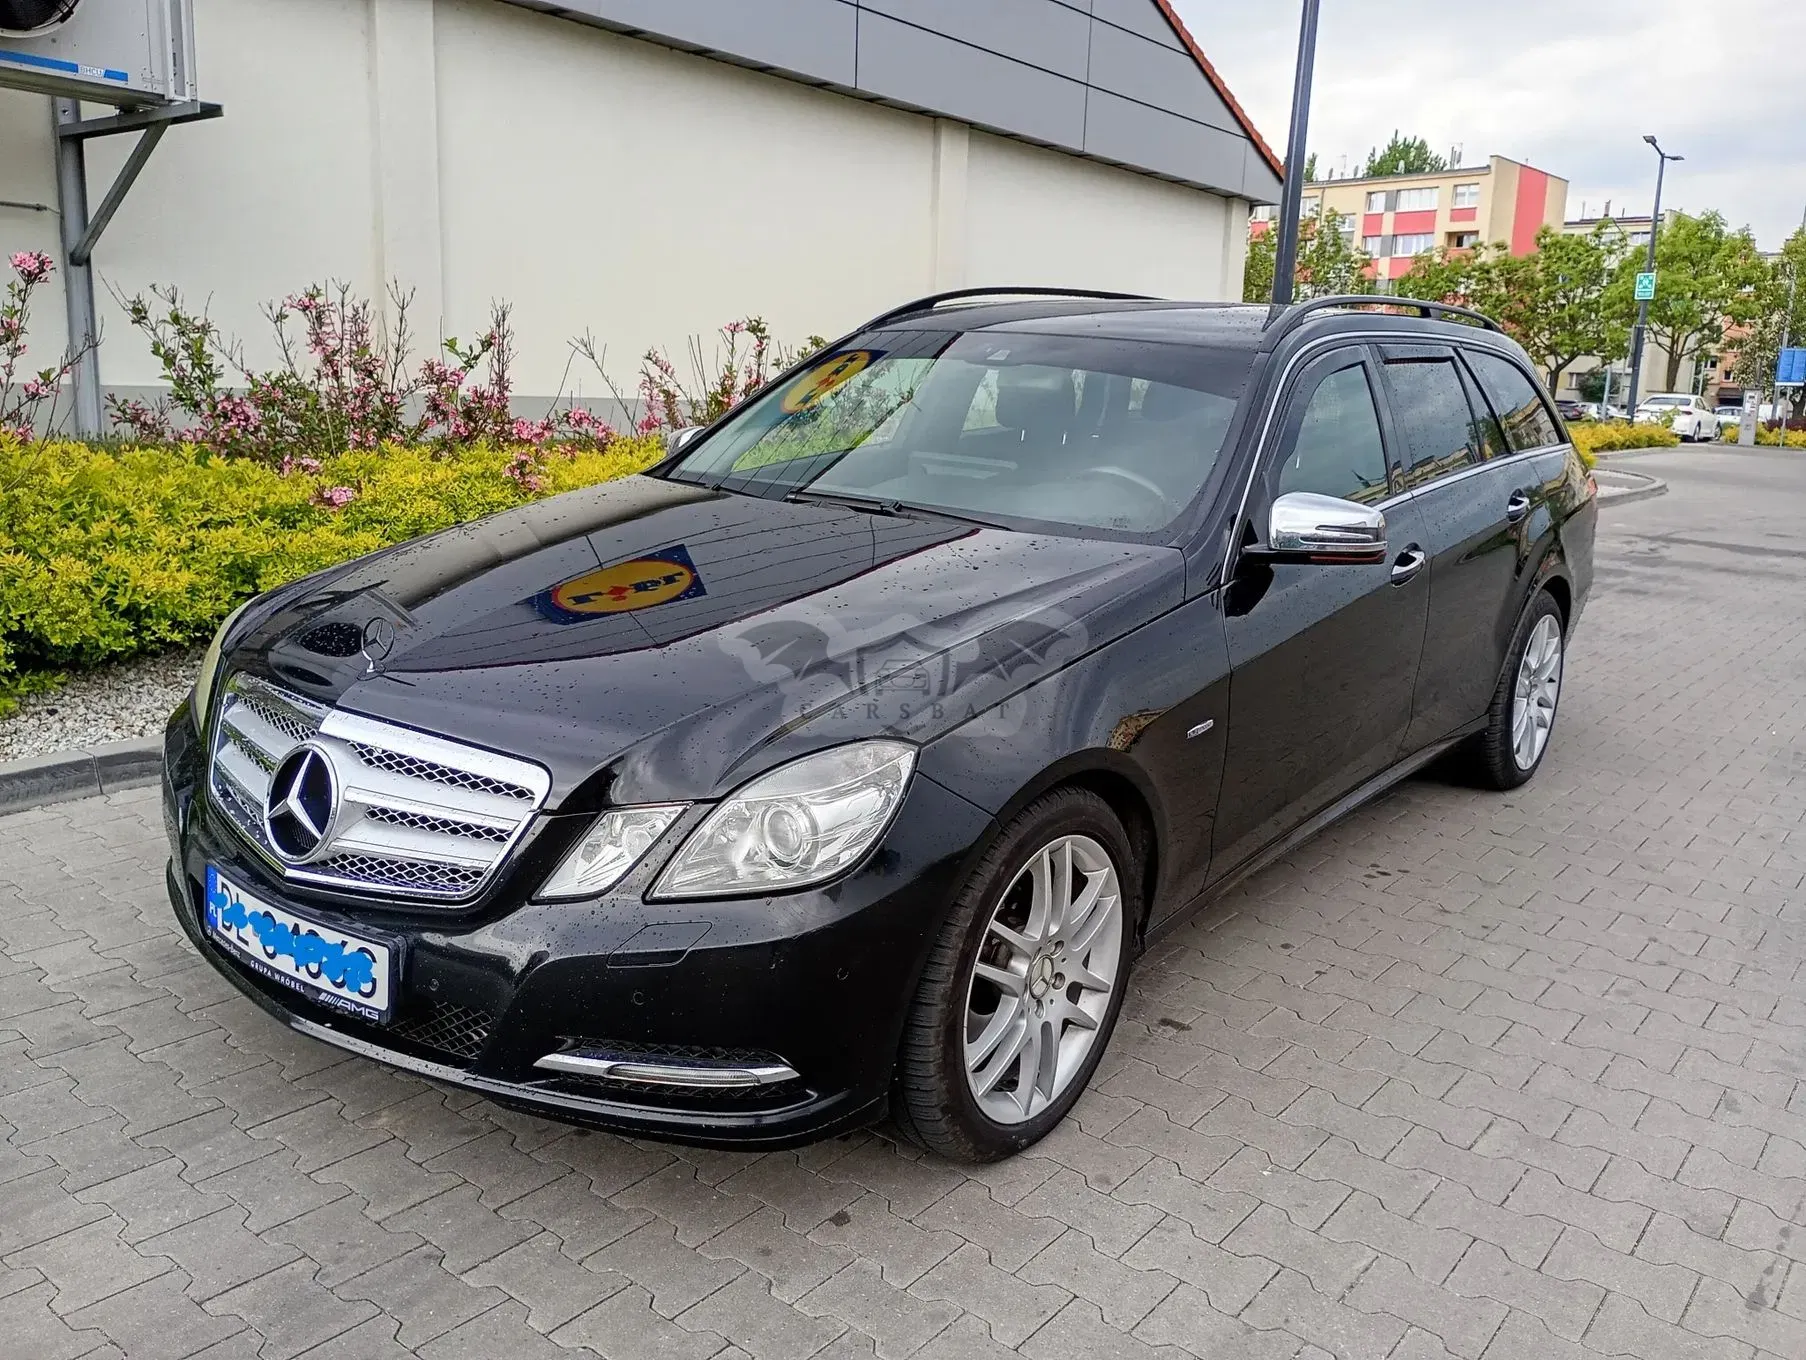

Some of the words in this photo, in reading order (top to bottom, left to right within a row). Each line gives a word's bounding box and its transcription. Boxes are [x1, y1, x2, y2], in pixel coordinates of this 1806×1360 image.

[250, 960, 272, 977] GRUPA
[274, 972, 305, 993] WRÓBEL
[337, 998, 379, 1020] AMG
